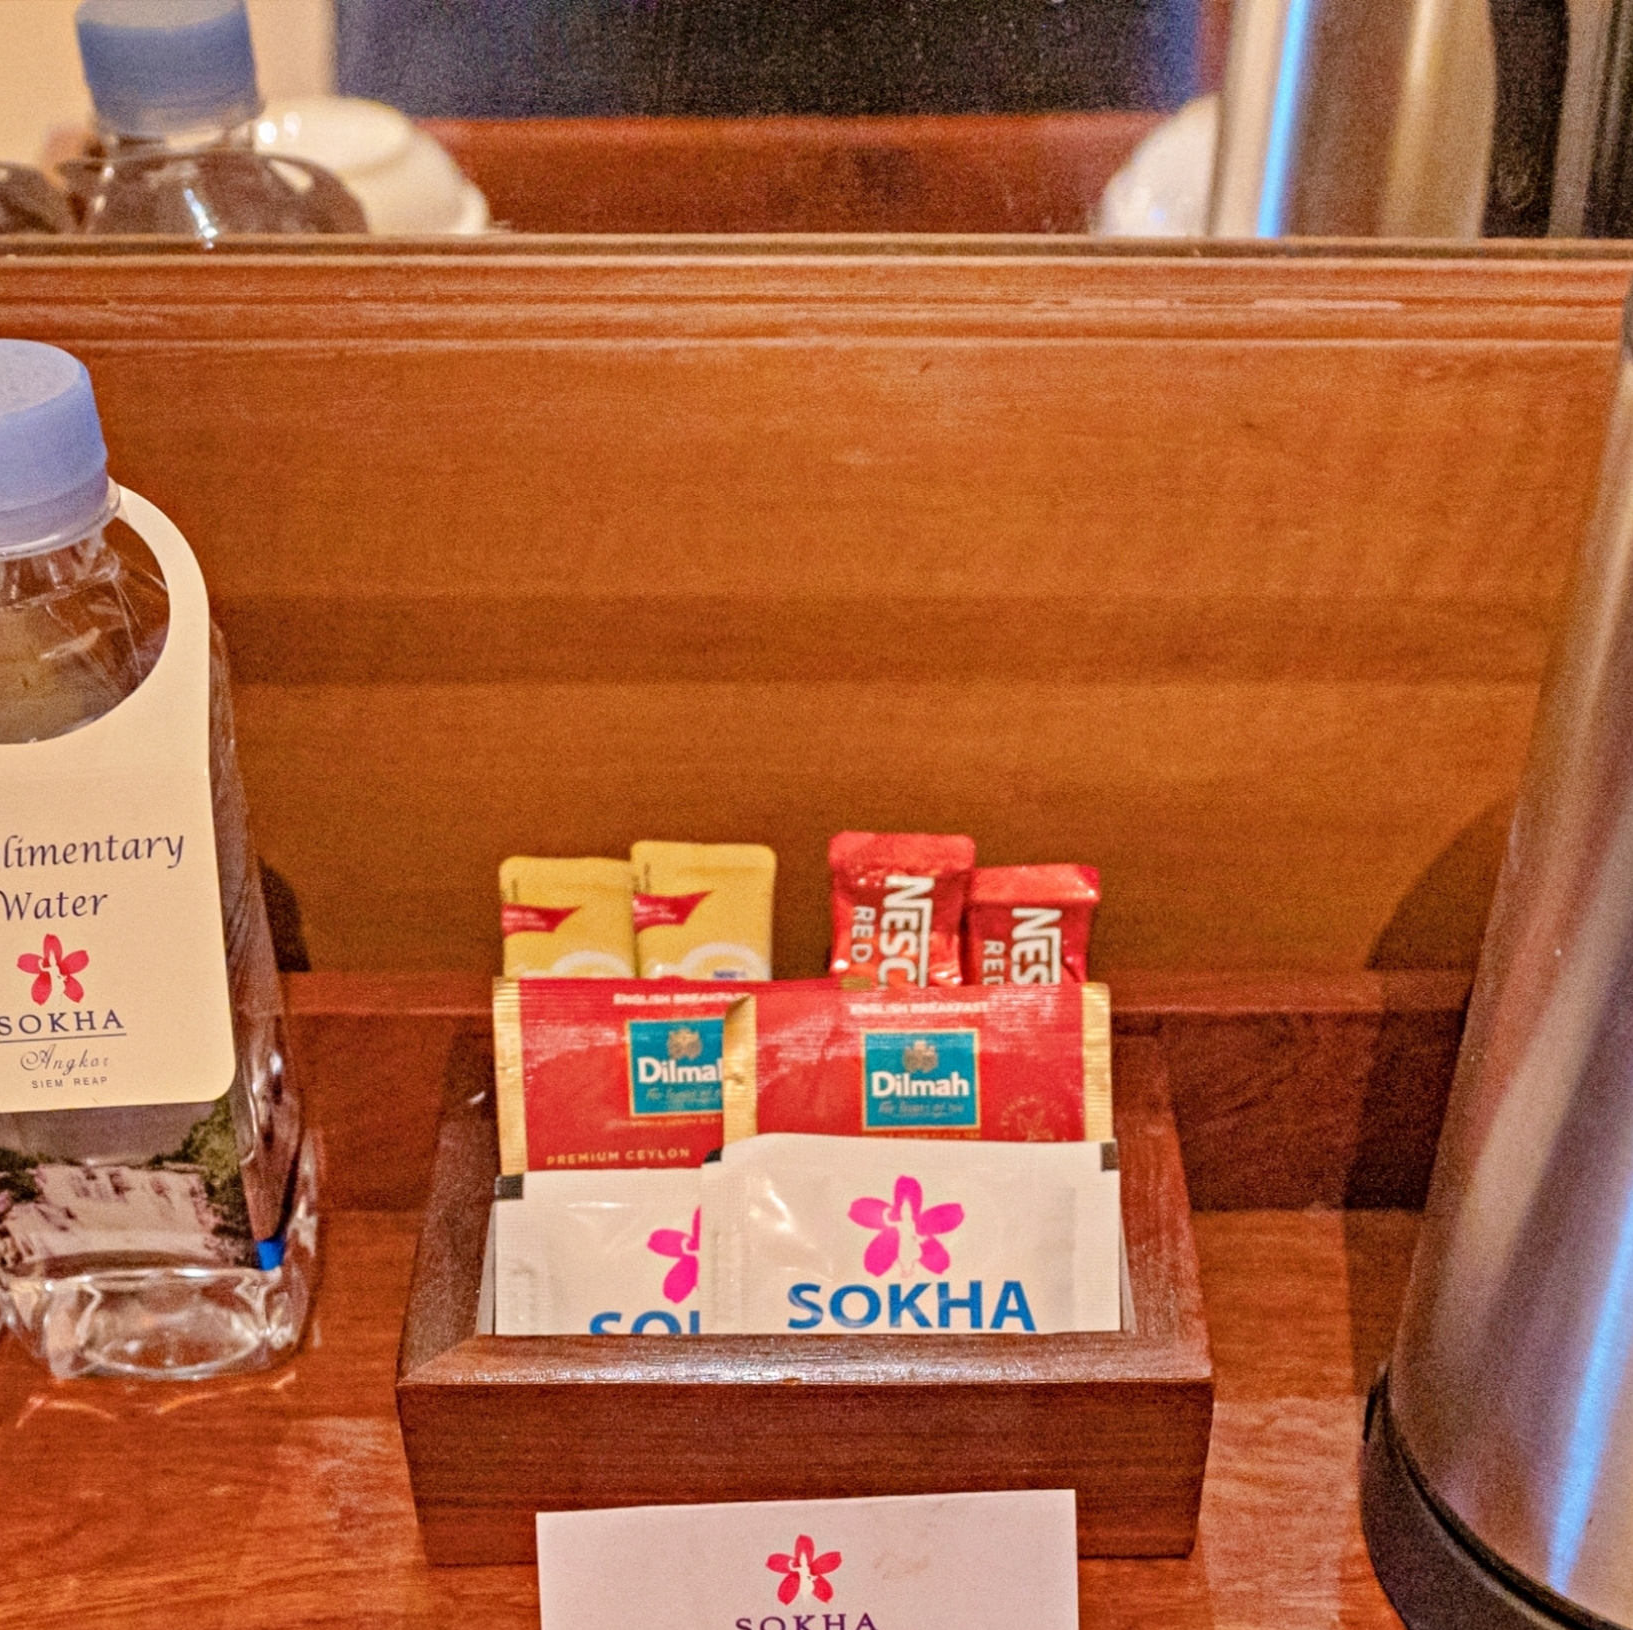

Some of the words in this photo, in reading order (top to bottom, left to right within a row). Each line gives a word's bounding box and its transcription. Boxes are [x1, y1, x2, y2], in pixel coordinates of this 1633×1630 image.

[850, 904, 877, 964] RED
[19, 1043, 110, 1076] Angkor
[31, 1079, 64, 1089] SIEM
[73, 1076, 108, 1086] REAP
[870, 1070, 970, 1098] Dilmah
[546, 1151, 618, 1166] PREMIUM
[625, 1148, 691, 1162] CEYLON
[787, 1279, 1037, 1332] SOKHA
